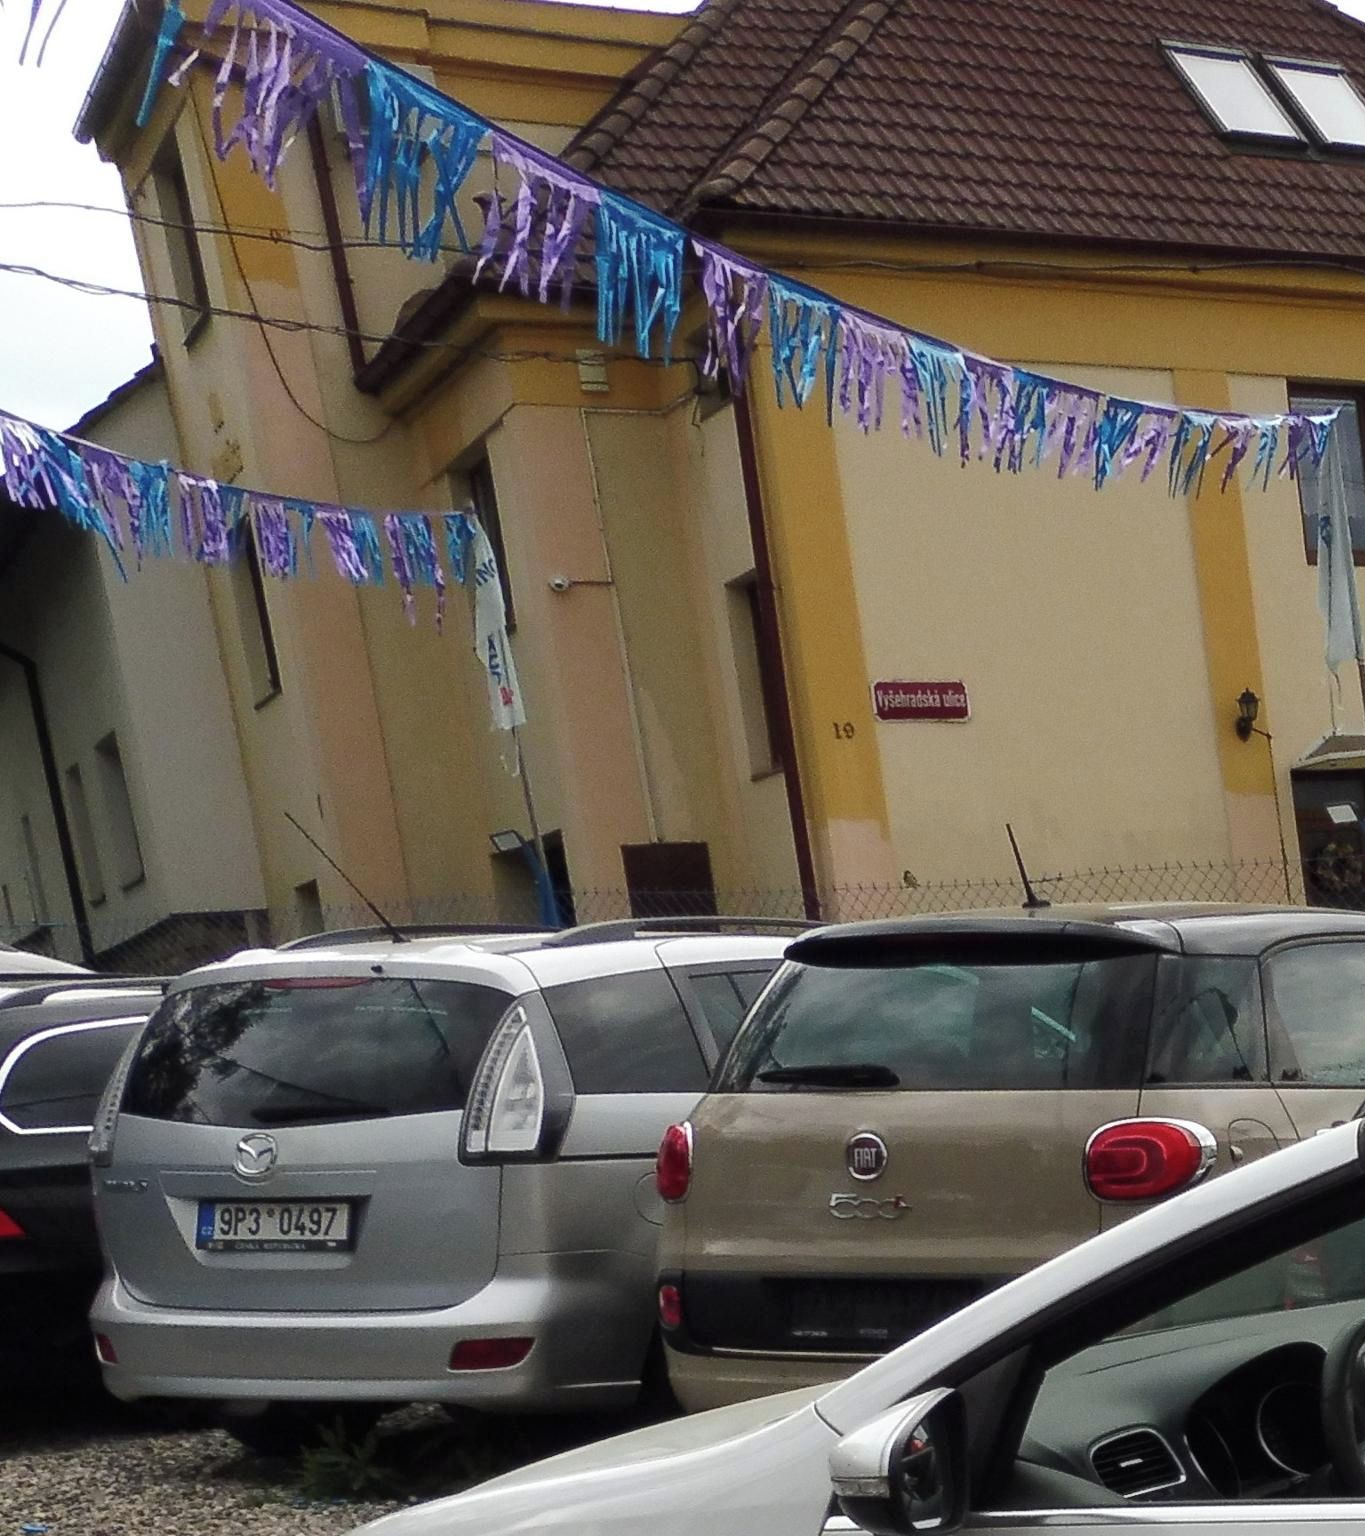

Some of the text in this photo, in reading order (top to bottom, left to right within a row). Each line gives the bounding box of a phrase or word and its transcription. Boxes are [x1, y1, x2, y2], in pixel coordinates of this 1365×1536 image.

[853, 1147, 878, 1169] FIAT
[201, 1226, 213, 1236] CZ
[218, 1207, 338, 1237] 9P3 0497
